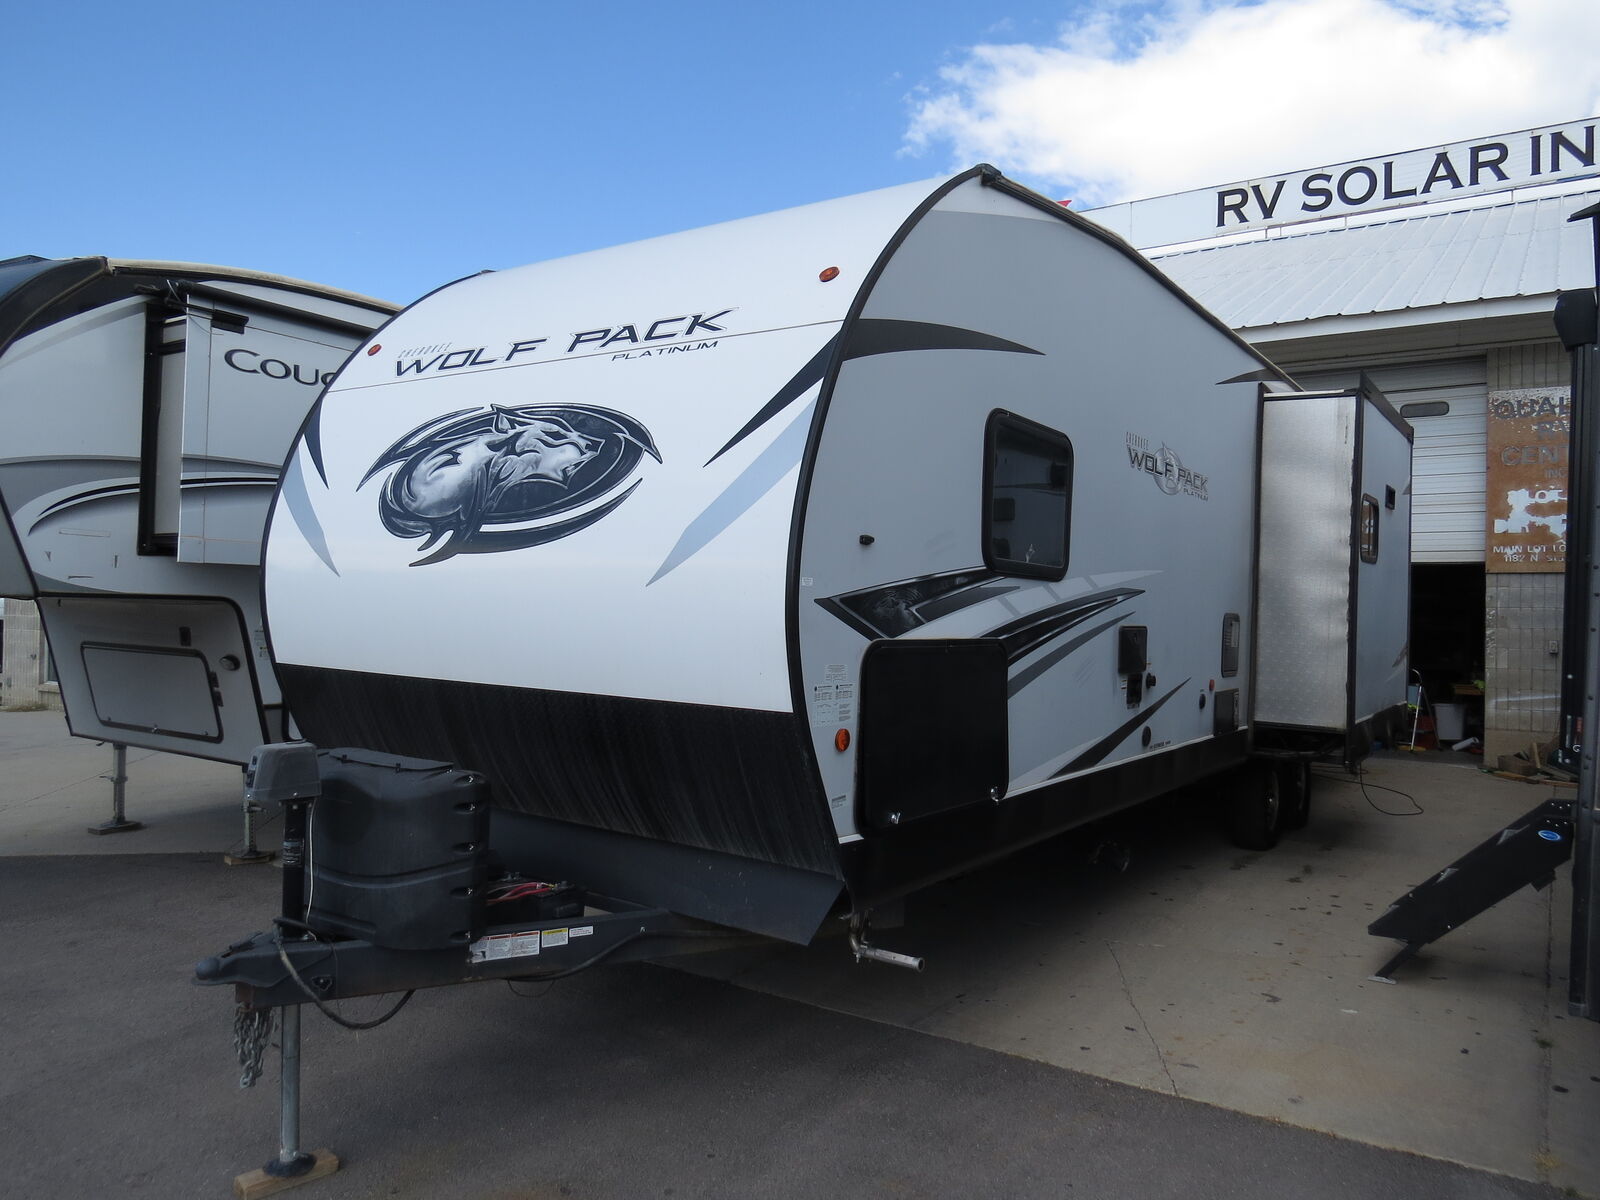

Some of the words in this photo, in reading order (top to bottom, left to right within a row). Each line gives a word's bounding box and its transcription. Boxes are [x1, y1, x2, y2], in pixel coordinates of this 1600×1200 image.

[1216, 180, 1286, 228] RV
[1301, 142, 1510, 212] SOLAR
[395, 337, 549, 377] WOLF
[565, 308, 738, 353] PACK
[611, 341, 719, 361] PLATINUM
[1126, 445, 1174, 477] WOLF
[1177, 467, 1208, 491] PACK
[1527, 545, 1547, 553] LOT
[1530, 554, 1539, 562] N
